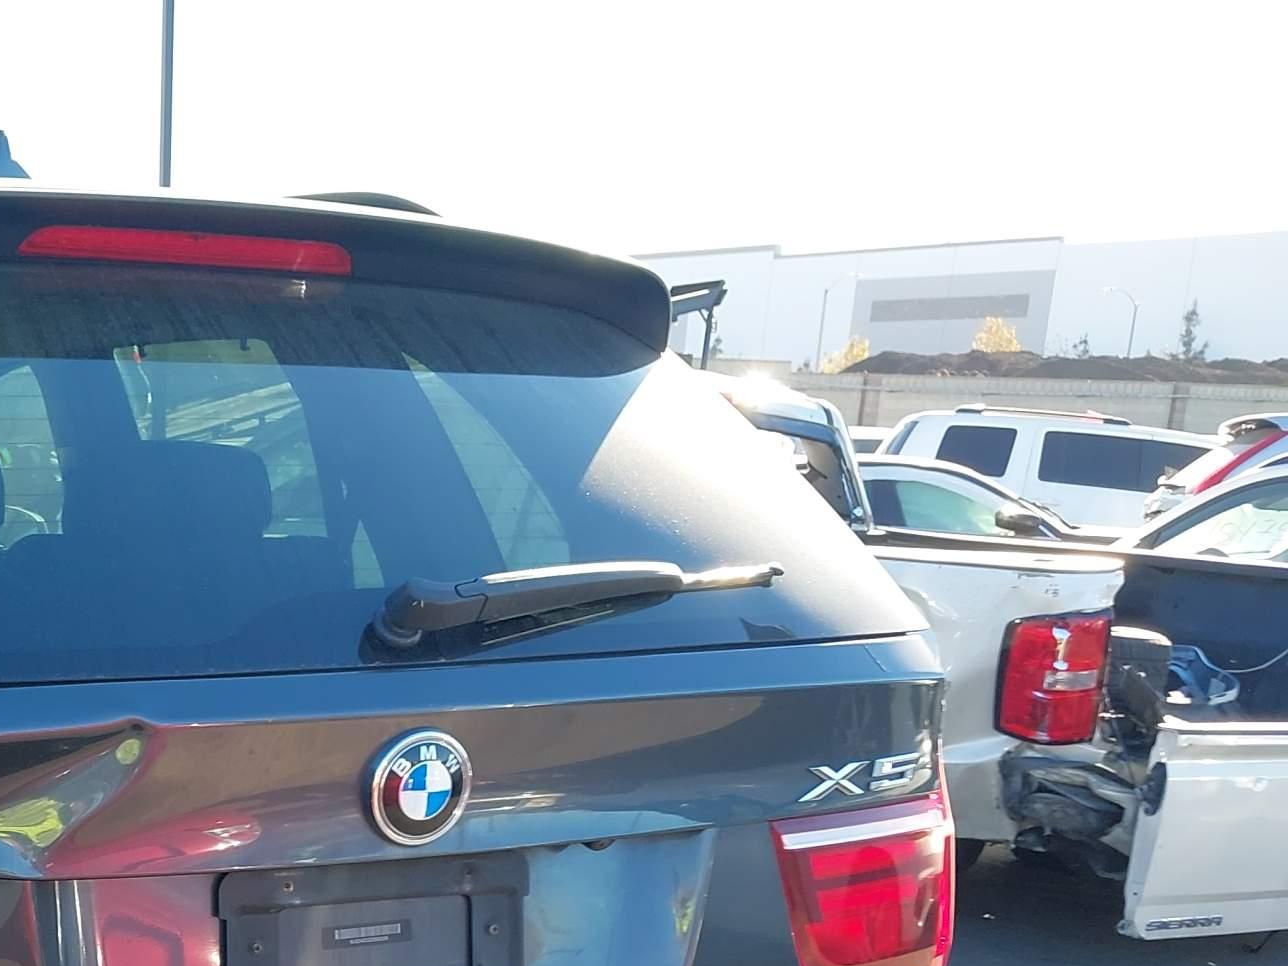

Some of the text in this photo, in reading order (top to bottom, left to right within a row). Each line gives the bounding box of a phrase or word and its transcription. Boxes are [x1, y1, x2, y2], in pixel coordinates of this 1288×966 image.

[391, 744, 461, 777] BMW
[798, 752, 921, 802] X5
[1145, 914, 1224, 931] SIERRA
